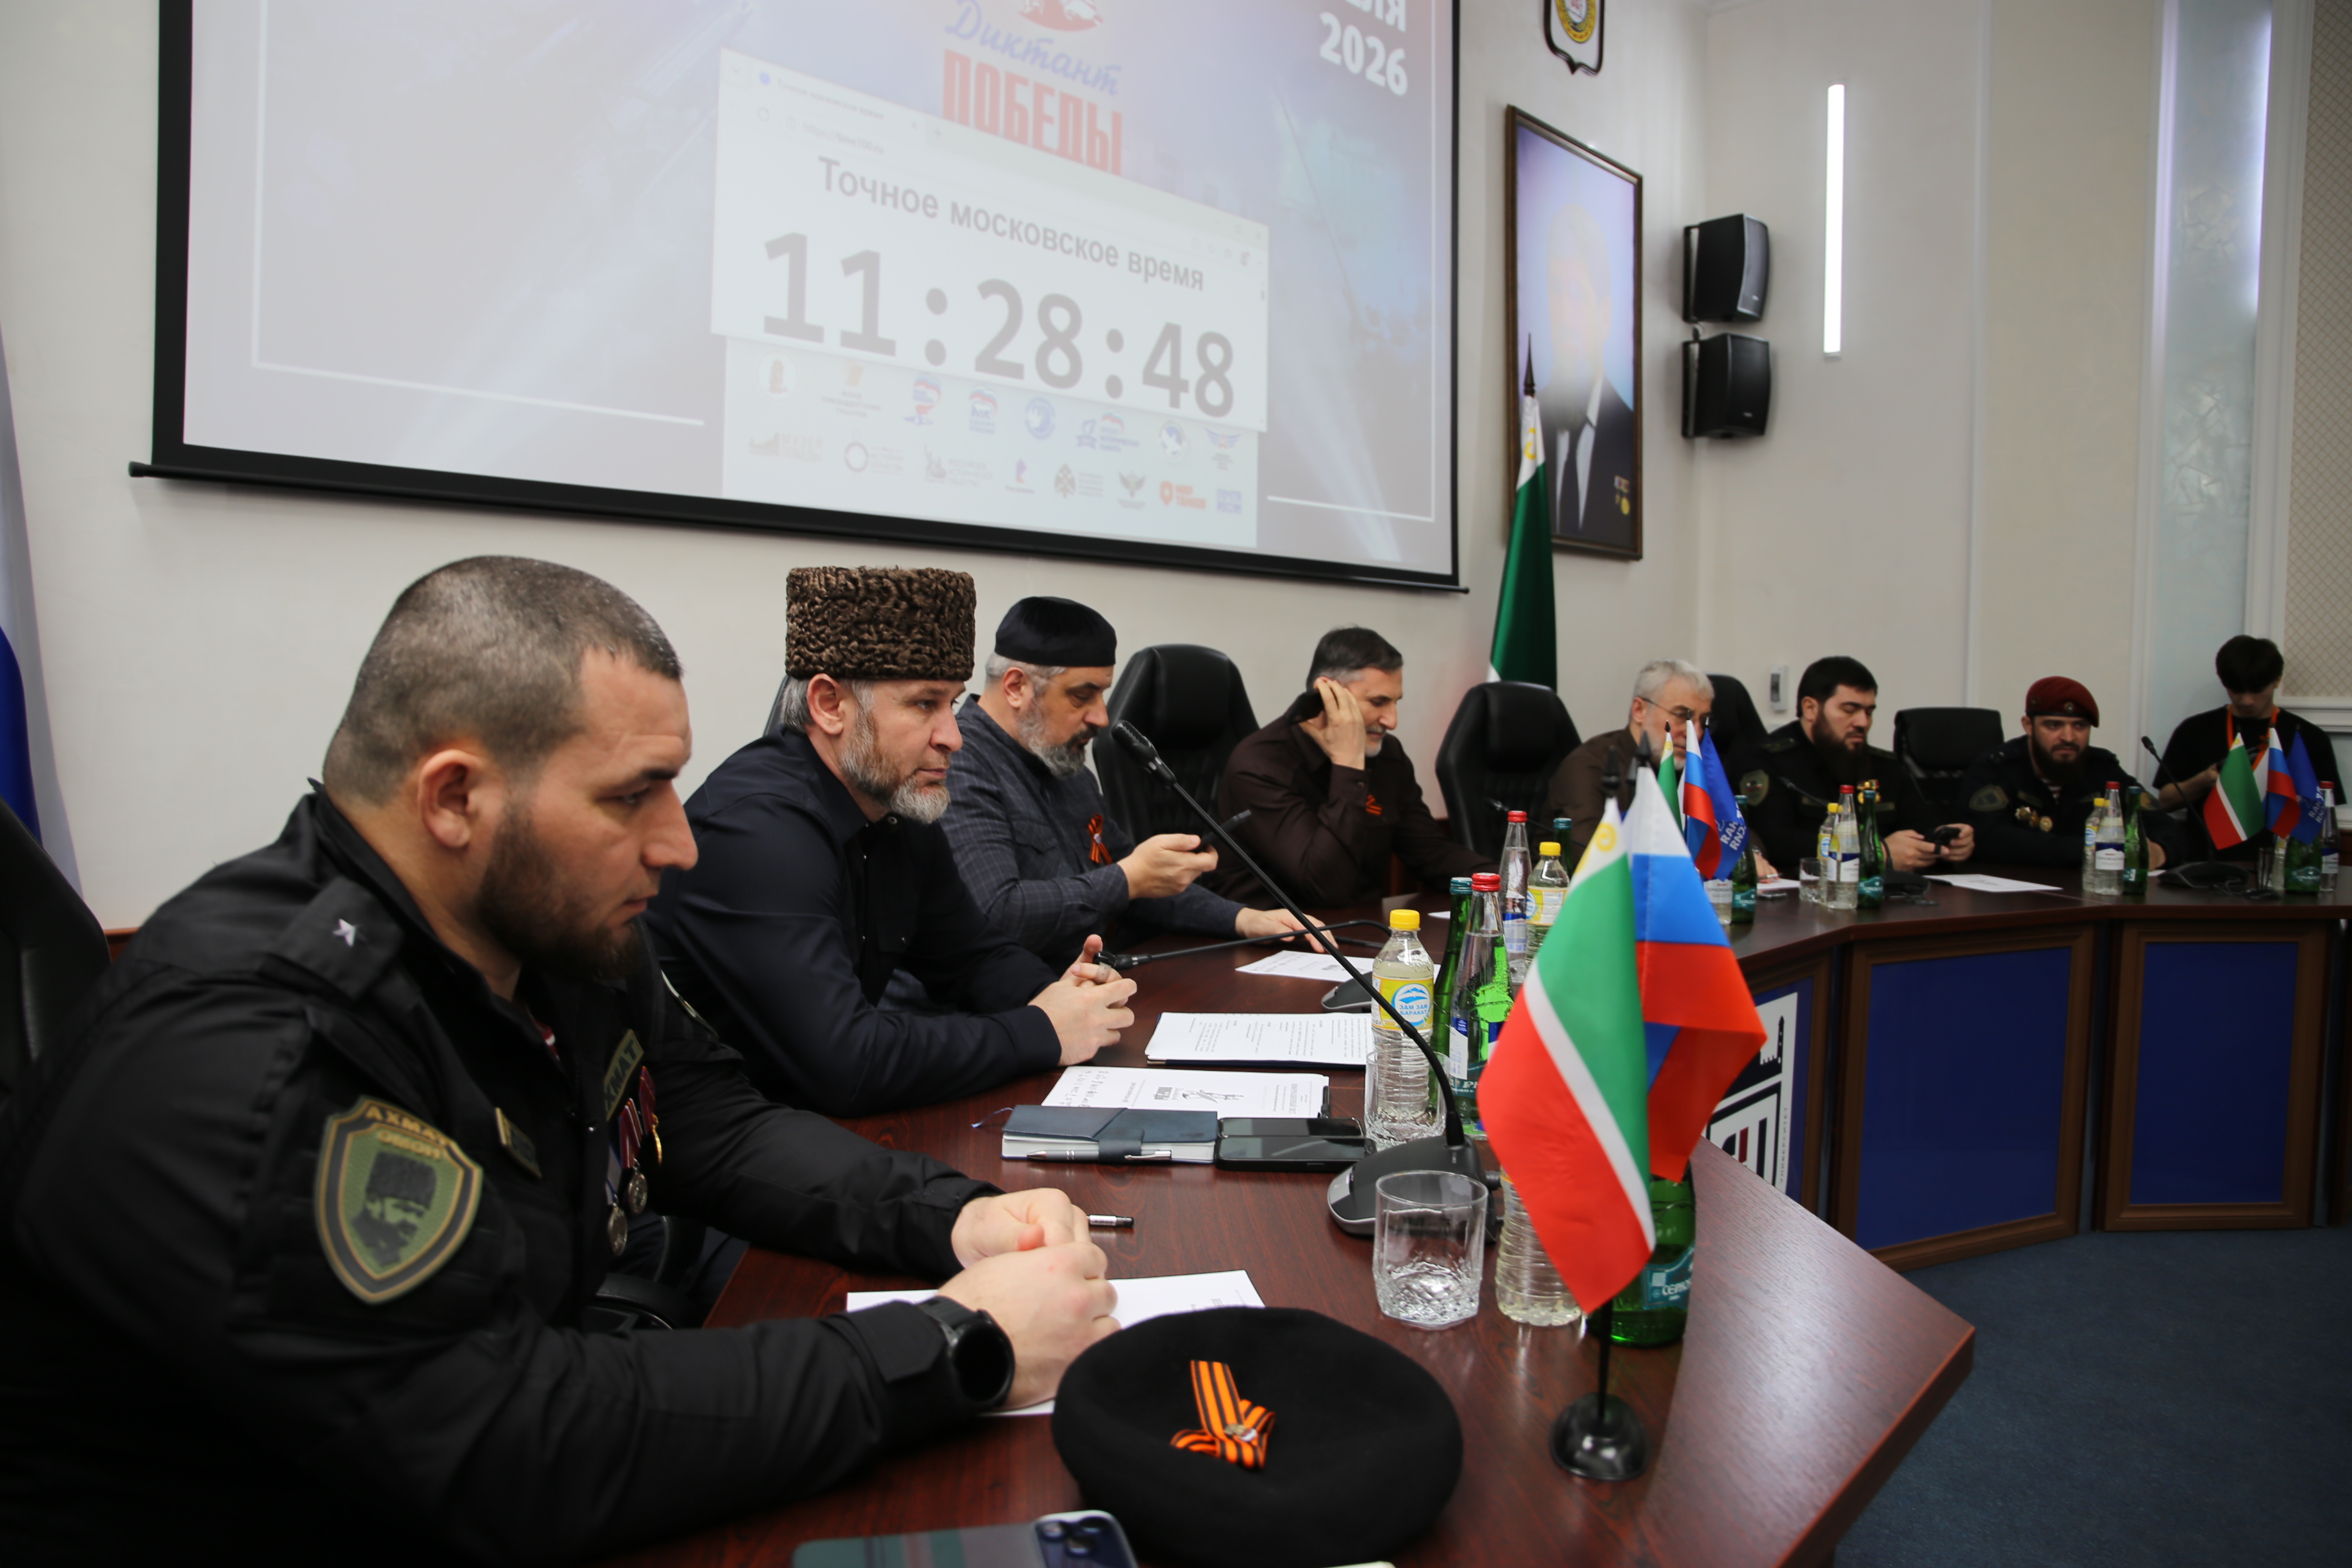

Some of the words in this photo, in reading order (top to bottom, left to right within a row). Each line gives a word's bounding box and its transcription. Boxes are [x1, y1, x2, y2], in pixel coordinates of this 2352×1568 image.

[944, 0, 1121, 95] Диктант
[1320, 12, 1408, 96] 2026
[943, 48, 1122, 176] ПОБЕДЫ
[818, 155, 939, 218] Точное
[950, 201, 1119, 268] московское
[1128, 250, 1204, 291] время
[763, 232, 1234, 418] 11:28:48
[605, 1038, 637, 1112] ХМАТ
